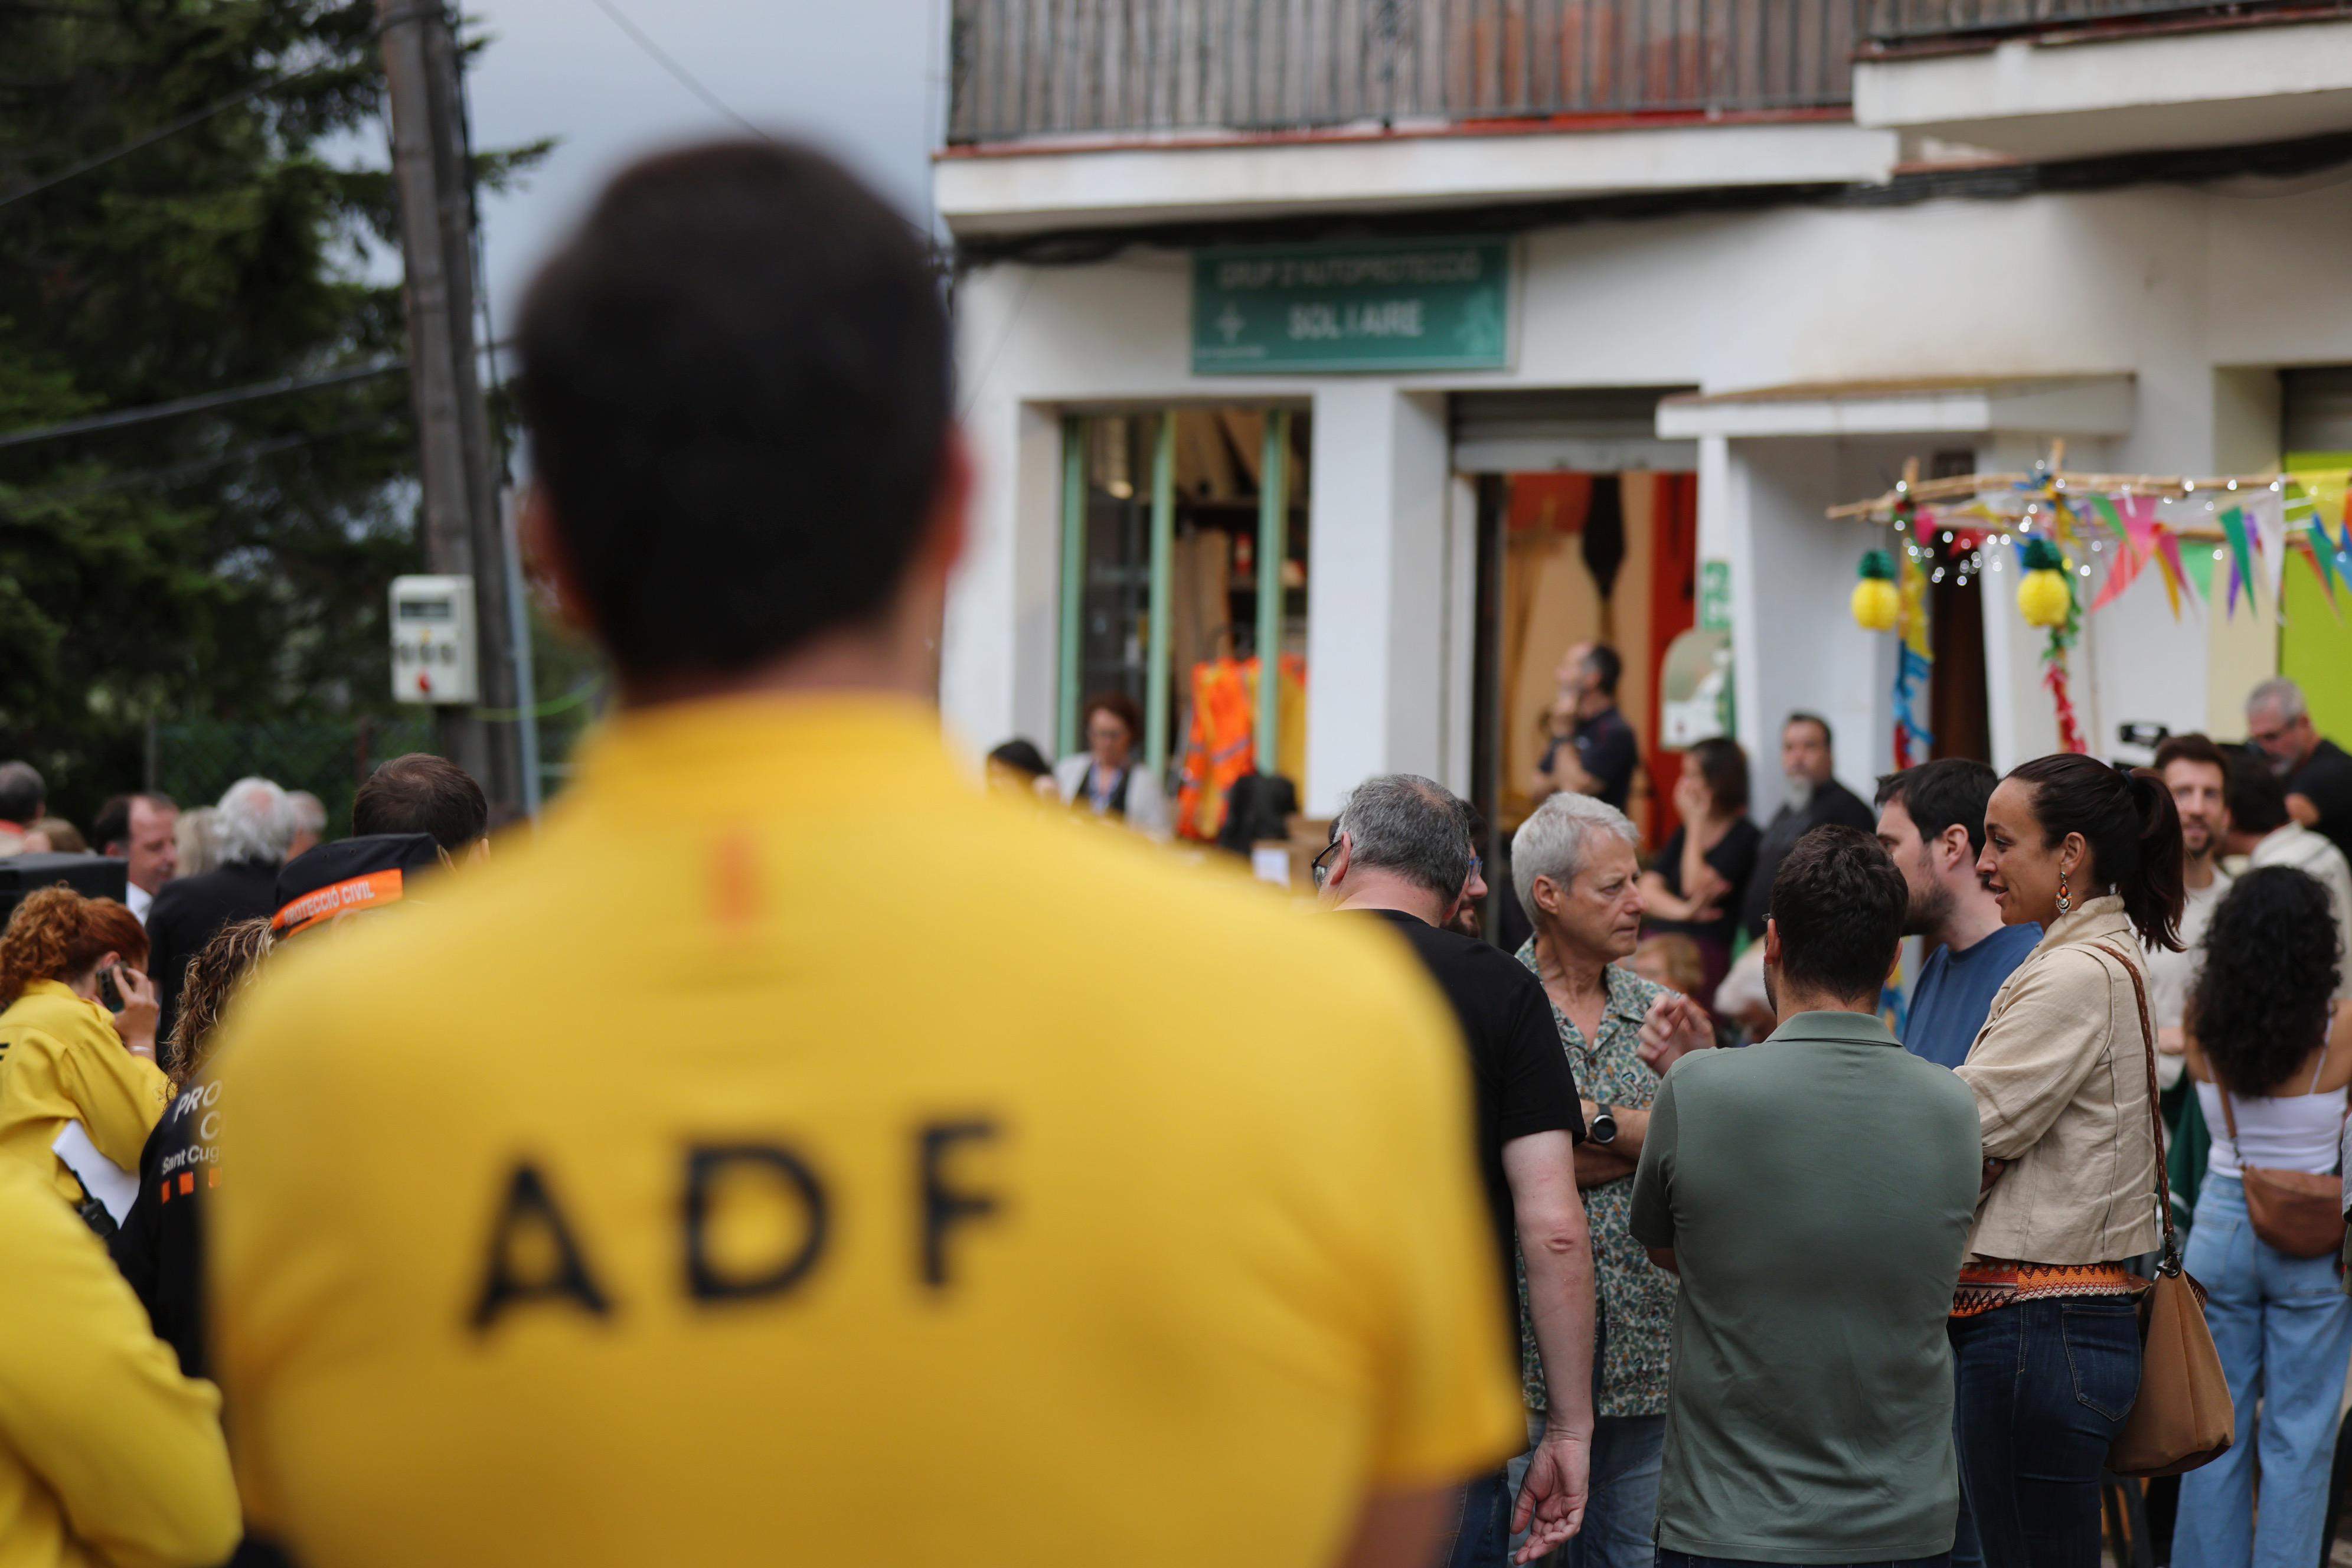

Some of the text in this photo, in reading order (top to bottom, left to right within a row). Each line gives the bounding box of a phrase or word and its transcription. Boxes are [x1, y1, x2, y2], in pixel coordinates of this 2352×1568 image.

[342, 881, 375, 904] CIVIL
[162, 1149, 186, 1175] Sant
[466, 1115, 1002, 1337] ADF
